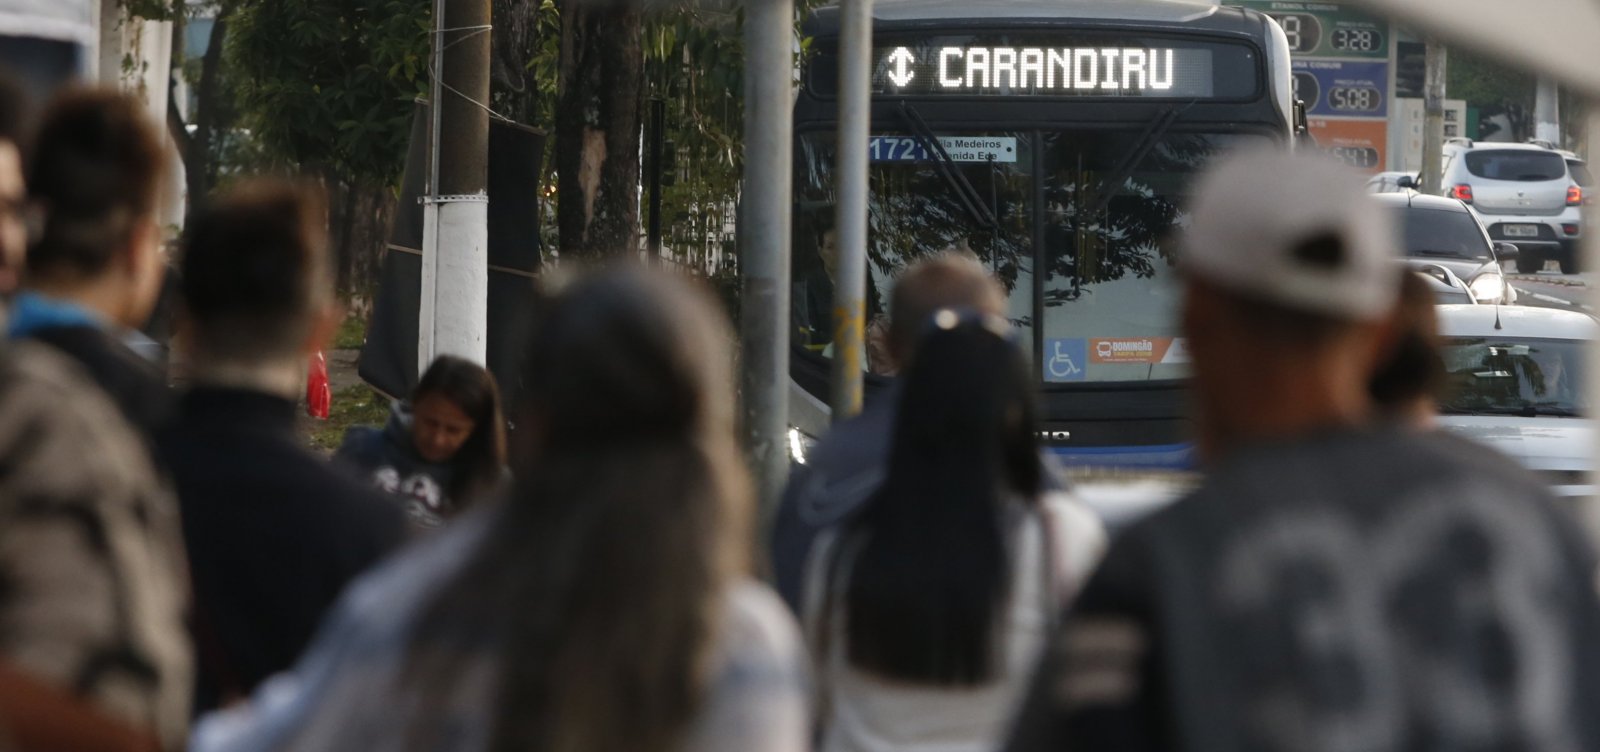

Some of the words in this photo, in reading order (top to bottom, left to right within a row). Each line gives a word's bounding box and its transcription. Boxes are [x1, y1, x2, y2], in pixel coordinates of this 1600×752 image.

[939, 47, 1173, 89] CARANDIRU
[955, 139, 1001, 148] Medeiros
[1112, 339, 1153, 351] DOMINGÃO
